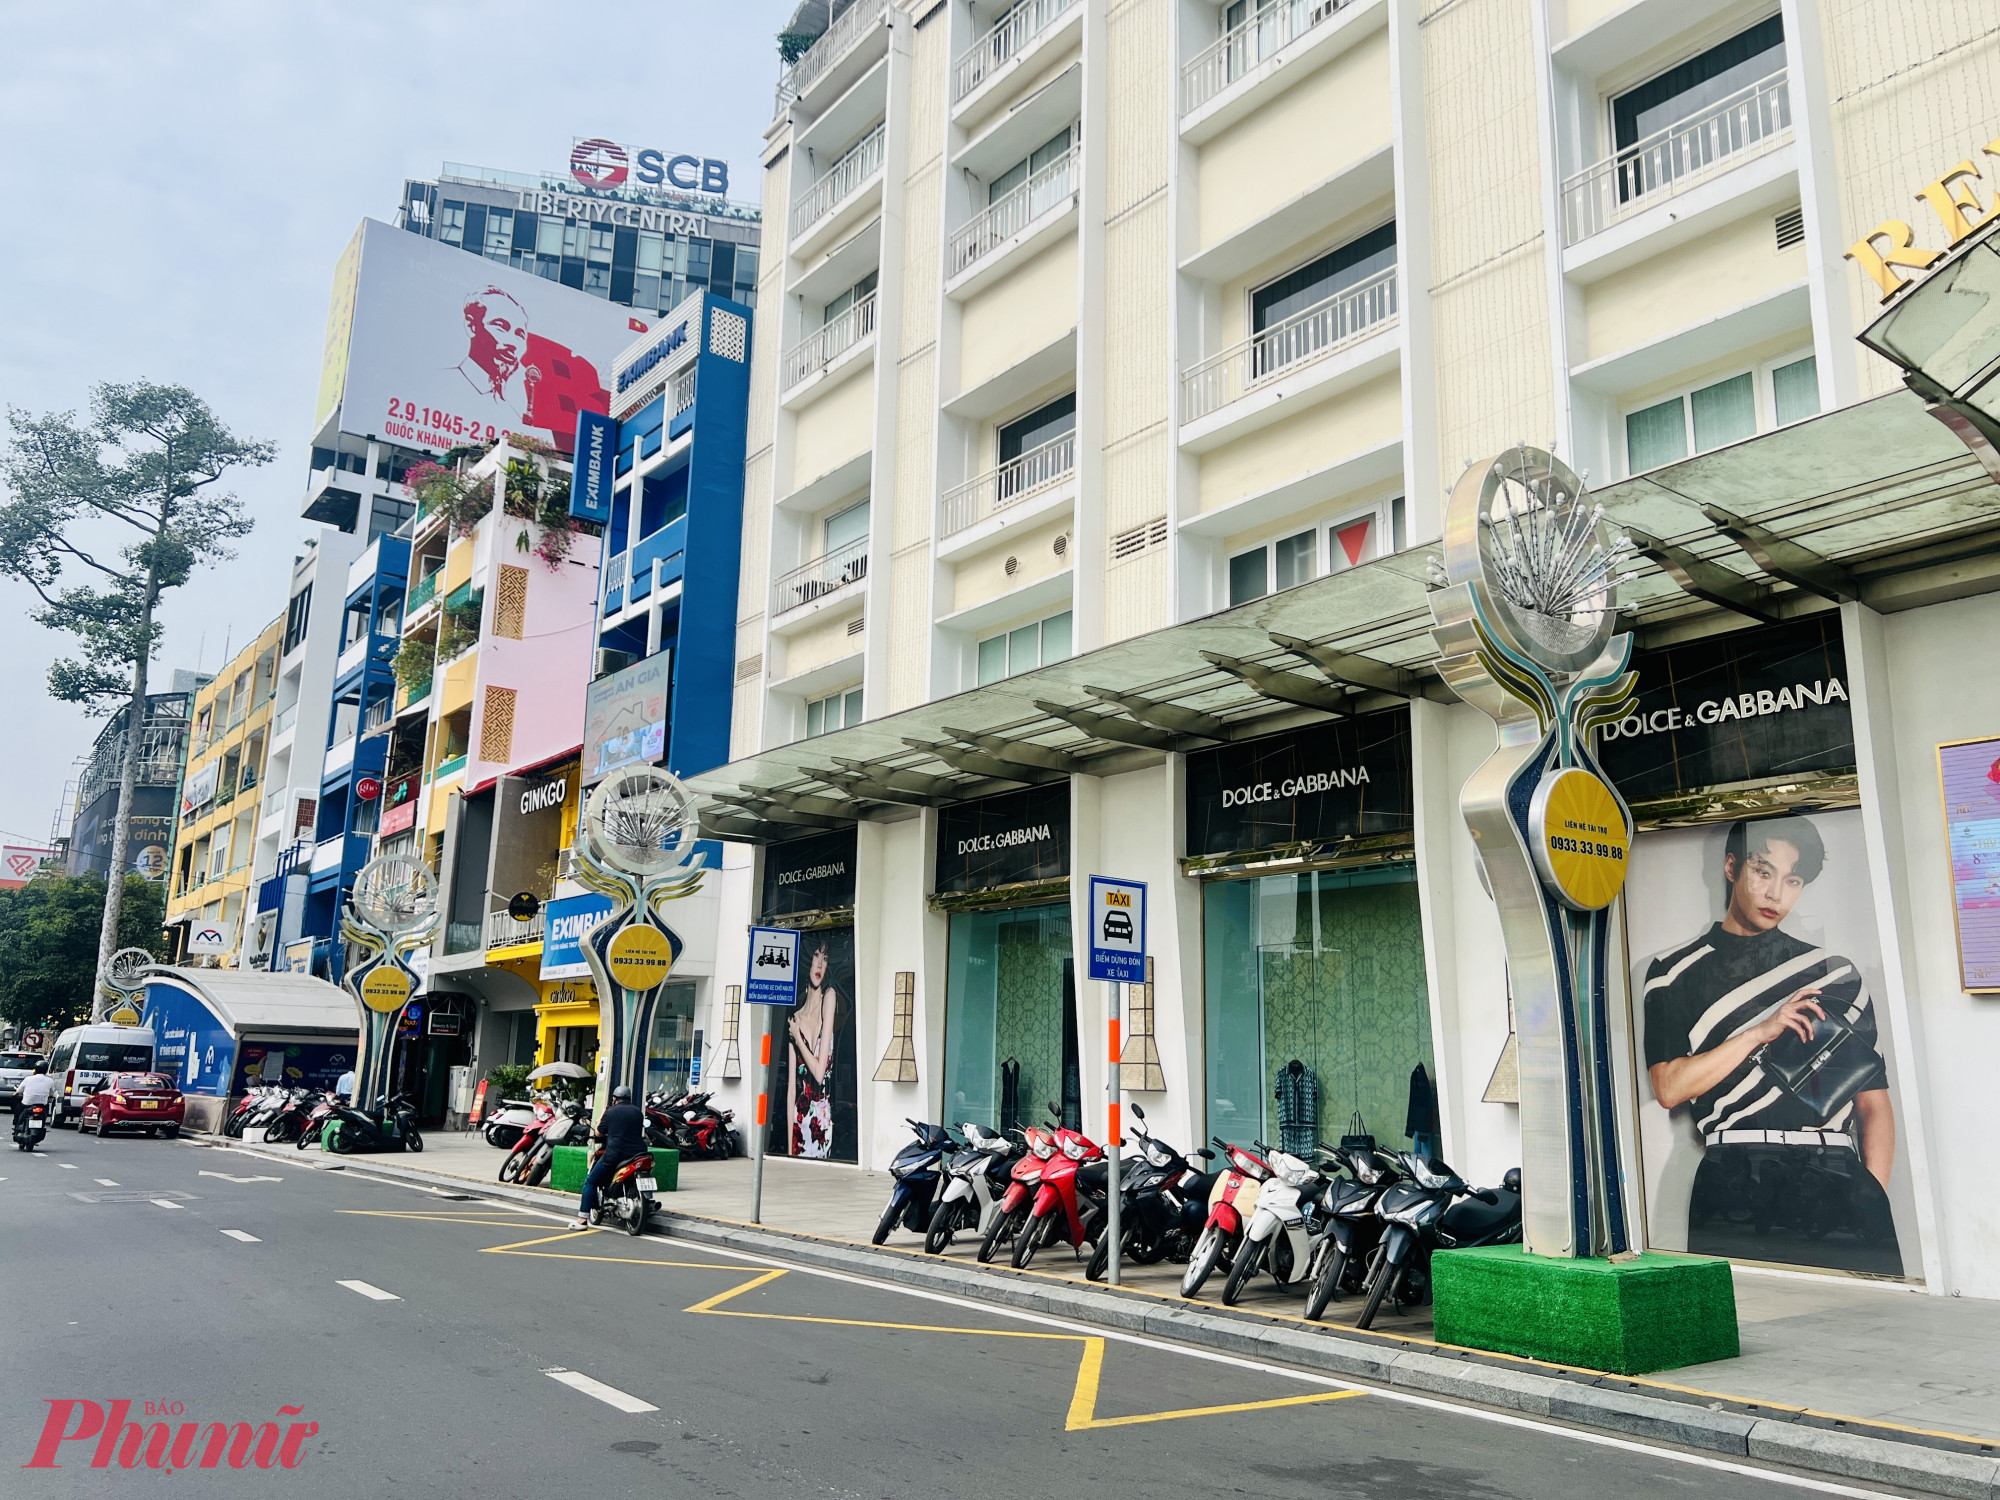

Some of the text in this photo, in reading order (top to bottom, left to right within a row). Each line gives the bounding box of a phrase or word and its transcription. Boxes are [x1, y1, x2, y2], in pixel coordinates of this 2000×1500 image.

[636, 148, 729, 194] SCB
[617, 320, 689, 394] EXIMBANK
[385, 421, 414, 440] QUỐC
[585, 424, 604, 510] EXIMBANK
[615, 666, 660, 695] AN GIA
[1603, 707, 1682, 742] DOLCE
[1697, 677, 1848, 725] GABBANA
[520, 778, 566, 815] GINKGO
[1222, 782, 1272, 808] DOLCE
[1281, 765, 1370, 798] GABBANA
[958, 834, 991, 855] DOLCE
[996, 824, 1050, 848] GABBANA
[1564, 820, 1607, 835] LIÊN HỆ TÀI TRỢ
[1551, 835, 1623, 860] 0933.33.99.88
[143, 855, 163, 868] 12
[779, 870, 802, 885] DOLCE
[806, 861, 845, 880] GABBANA
[1108, 892, 1130, 907] TAXI
[551, 908, 613, 941] EXIMBAN
[614, 957, 666, 966] 0933.33.99.88
[1095, 951, 1109, 963] ĐIỂM
[1107, 969, 1128, 978] XE TAXI
